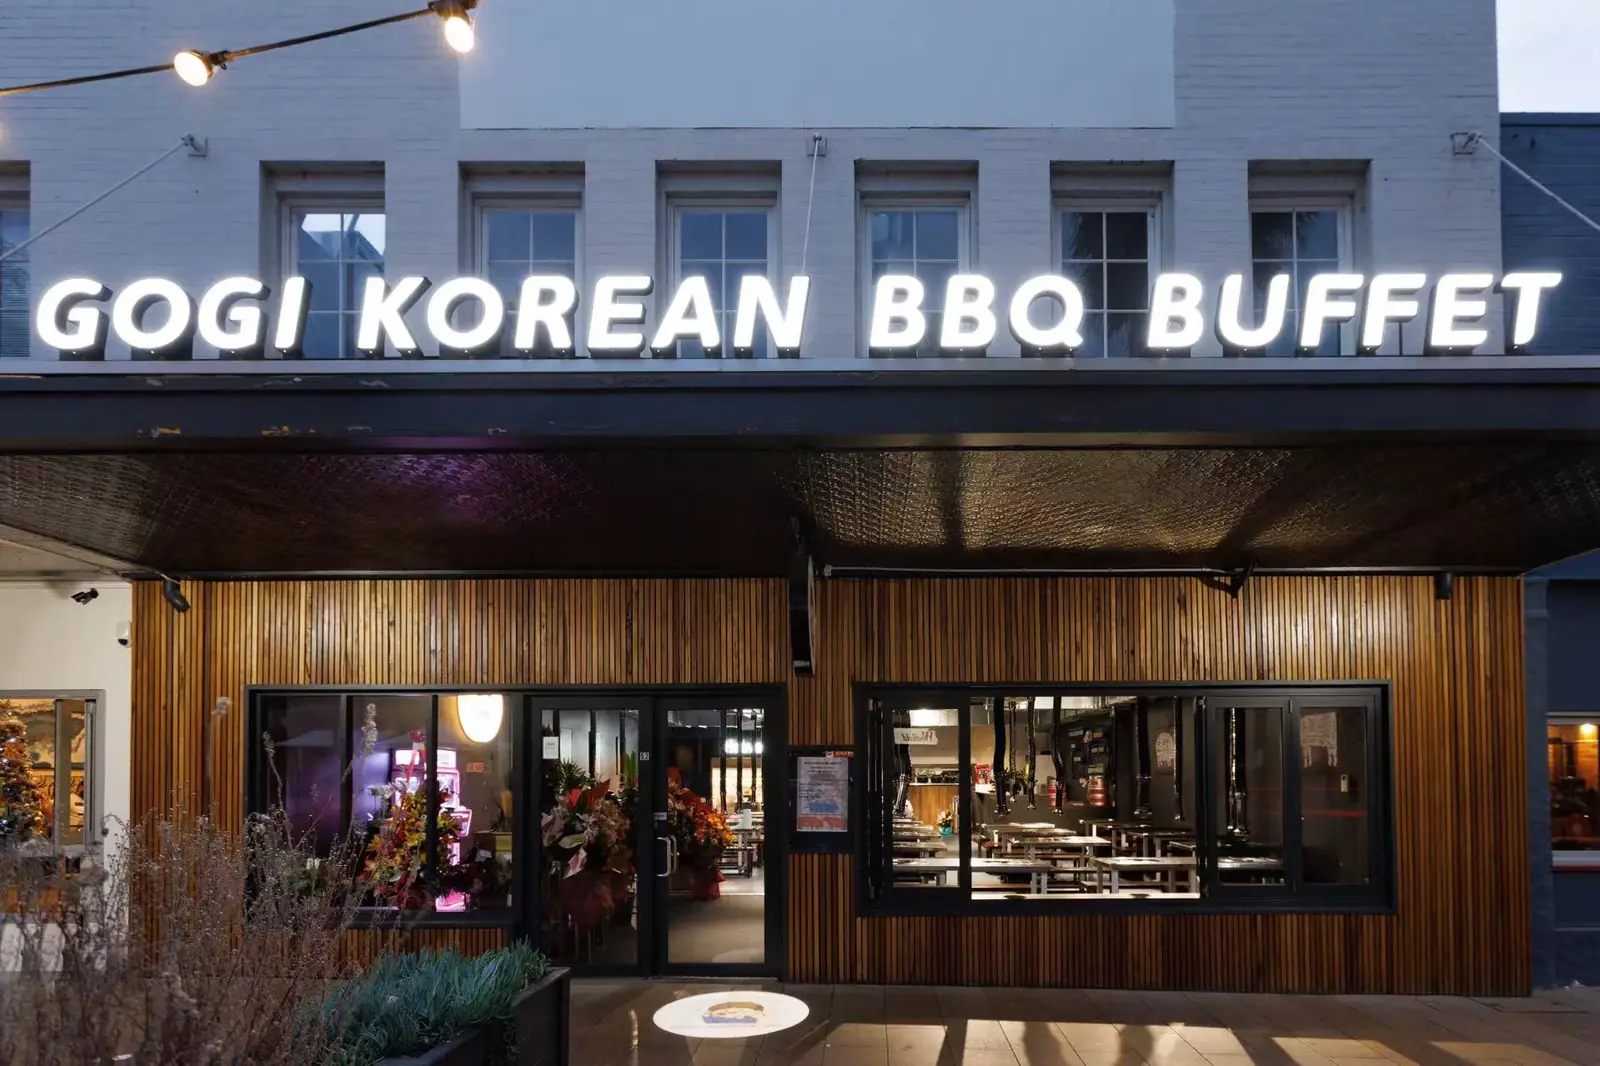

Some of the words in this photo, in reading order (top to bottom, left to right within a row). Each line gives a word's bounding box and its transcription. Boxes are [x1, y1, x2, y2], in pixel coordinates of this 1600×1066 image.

[36, 276, 306, 349] GOGI
[357, 275, 809, 349] KOREAN
[869, 274, 1083, 349] BBQ
[1146, 272, 1562, 349] BUFFET
